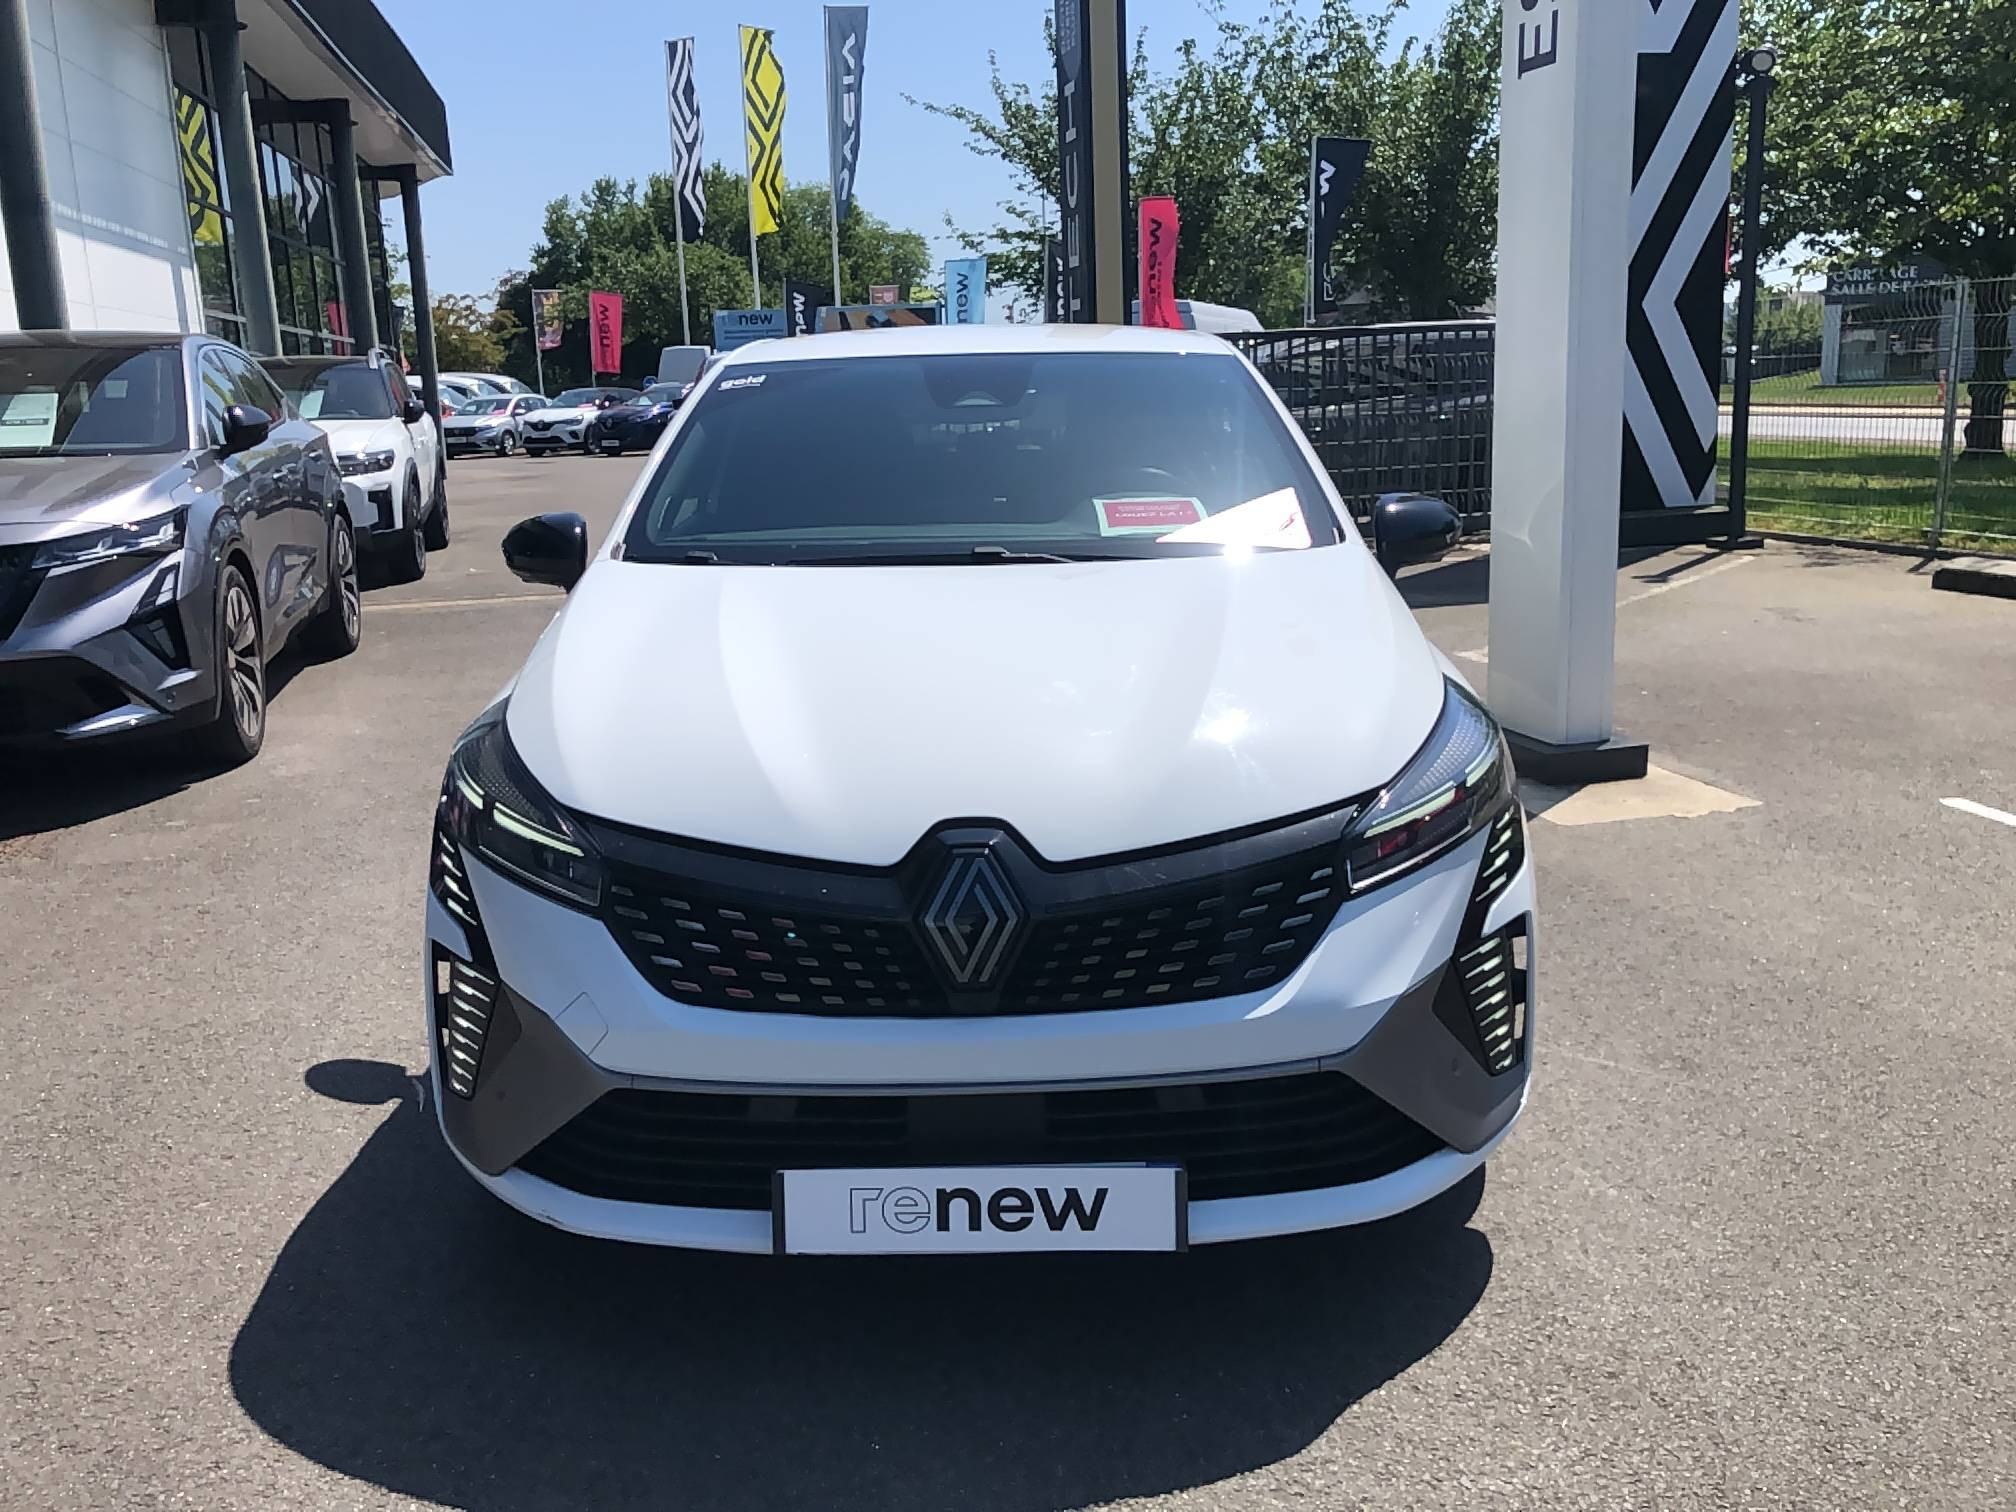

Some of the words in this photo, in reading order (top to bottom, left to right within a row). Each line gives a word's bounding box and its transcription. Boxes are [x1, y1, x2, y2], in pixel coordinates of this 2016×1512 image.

[1517, 0, 1559, 80] E
[1831, 282, 1873, 296] SALLE
[1879, 281, 1900, 294] DE
[1832, 265, 1919, 283] CARRLAGE
[850, 1186, 1109, 1234] renew
